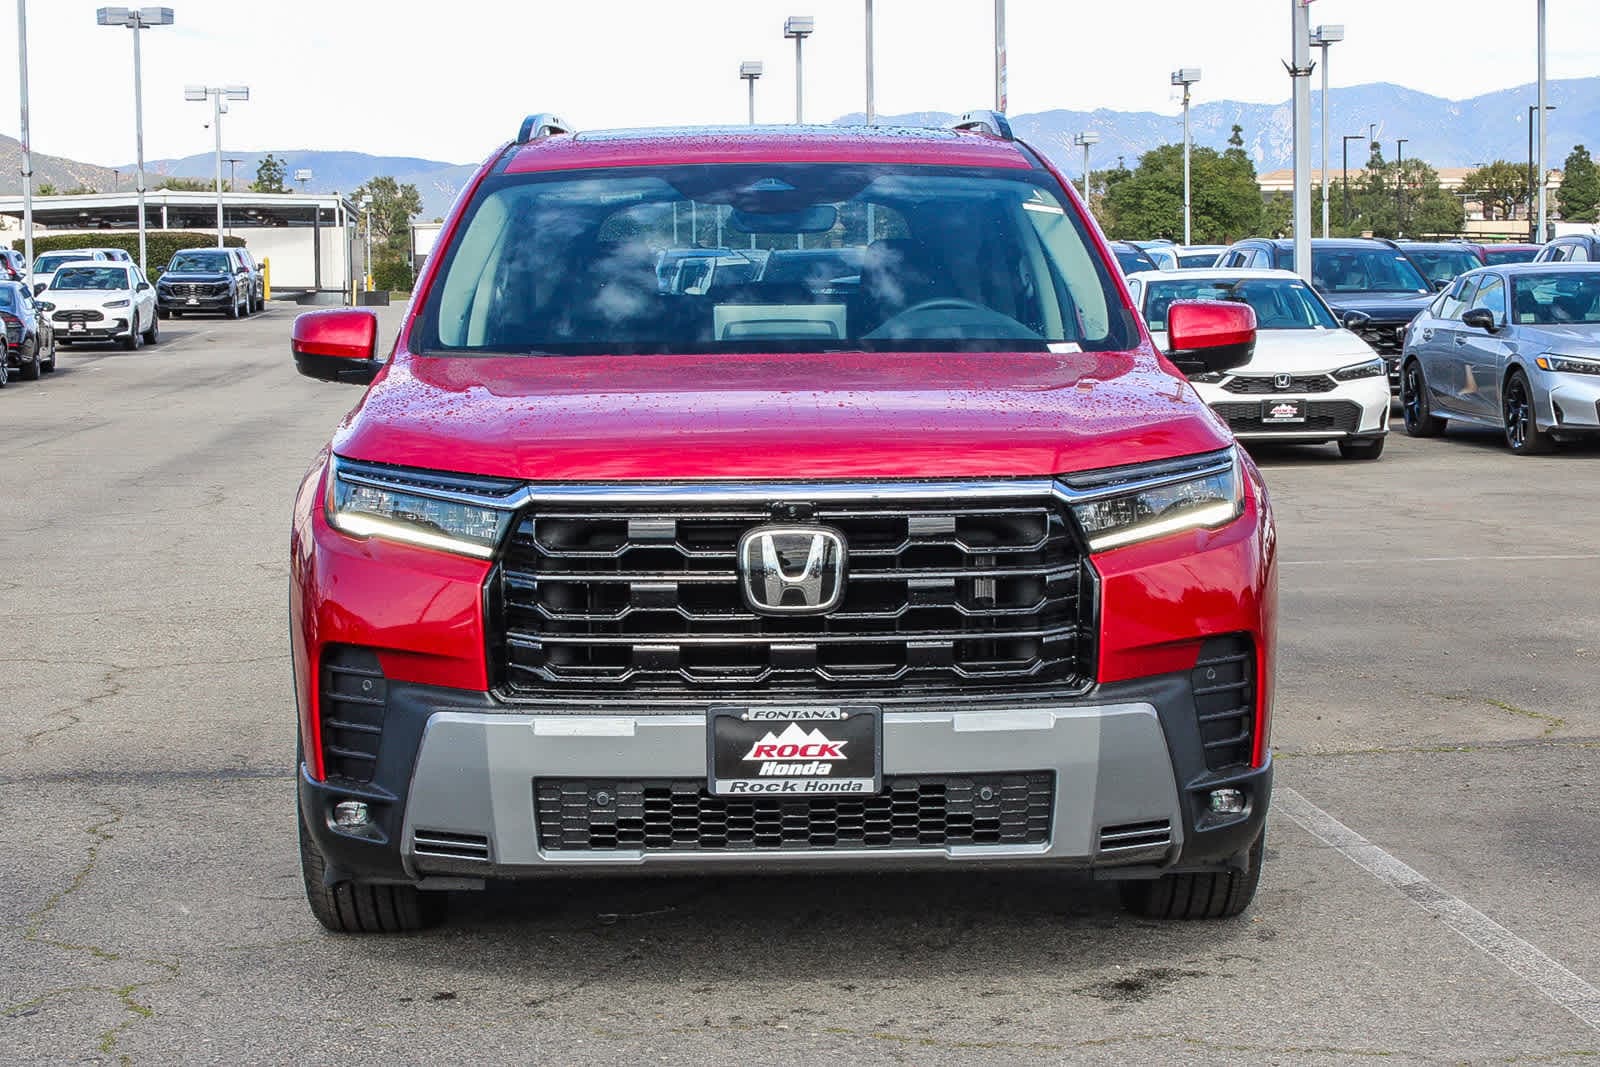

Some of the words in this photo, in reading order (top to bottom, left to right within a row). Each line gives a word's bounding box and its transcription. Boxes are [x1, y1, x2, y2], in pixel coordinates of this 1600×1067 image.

[753, 710, 837, 719] FONTANA
[752, 743, 841, 758] ROCK
[758, 761, 832, 776] Honda
[729, 781, 798, 793] Rock
[804, 780, 863, 792] Honda
